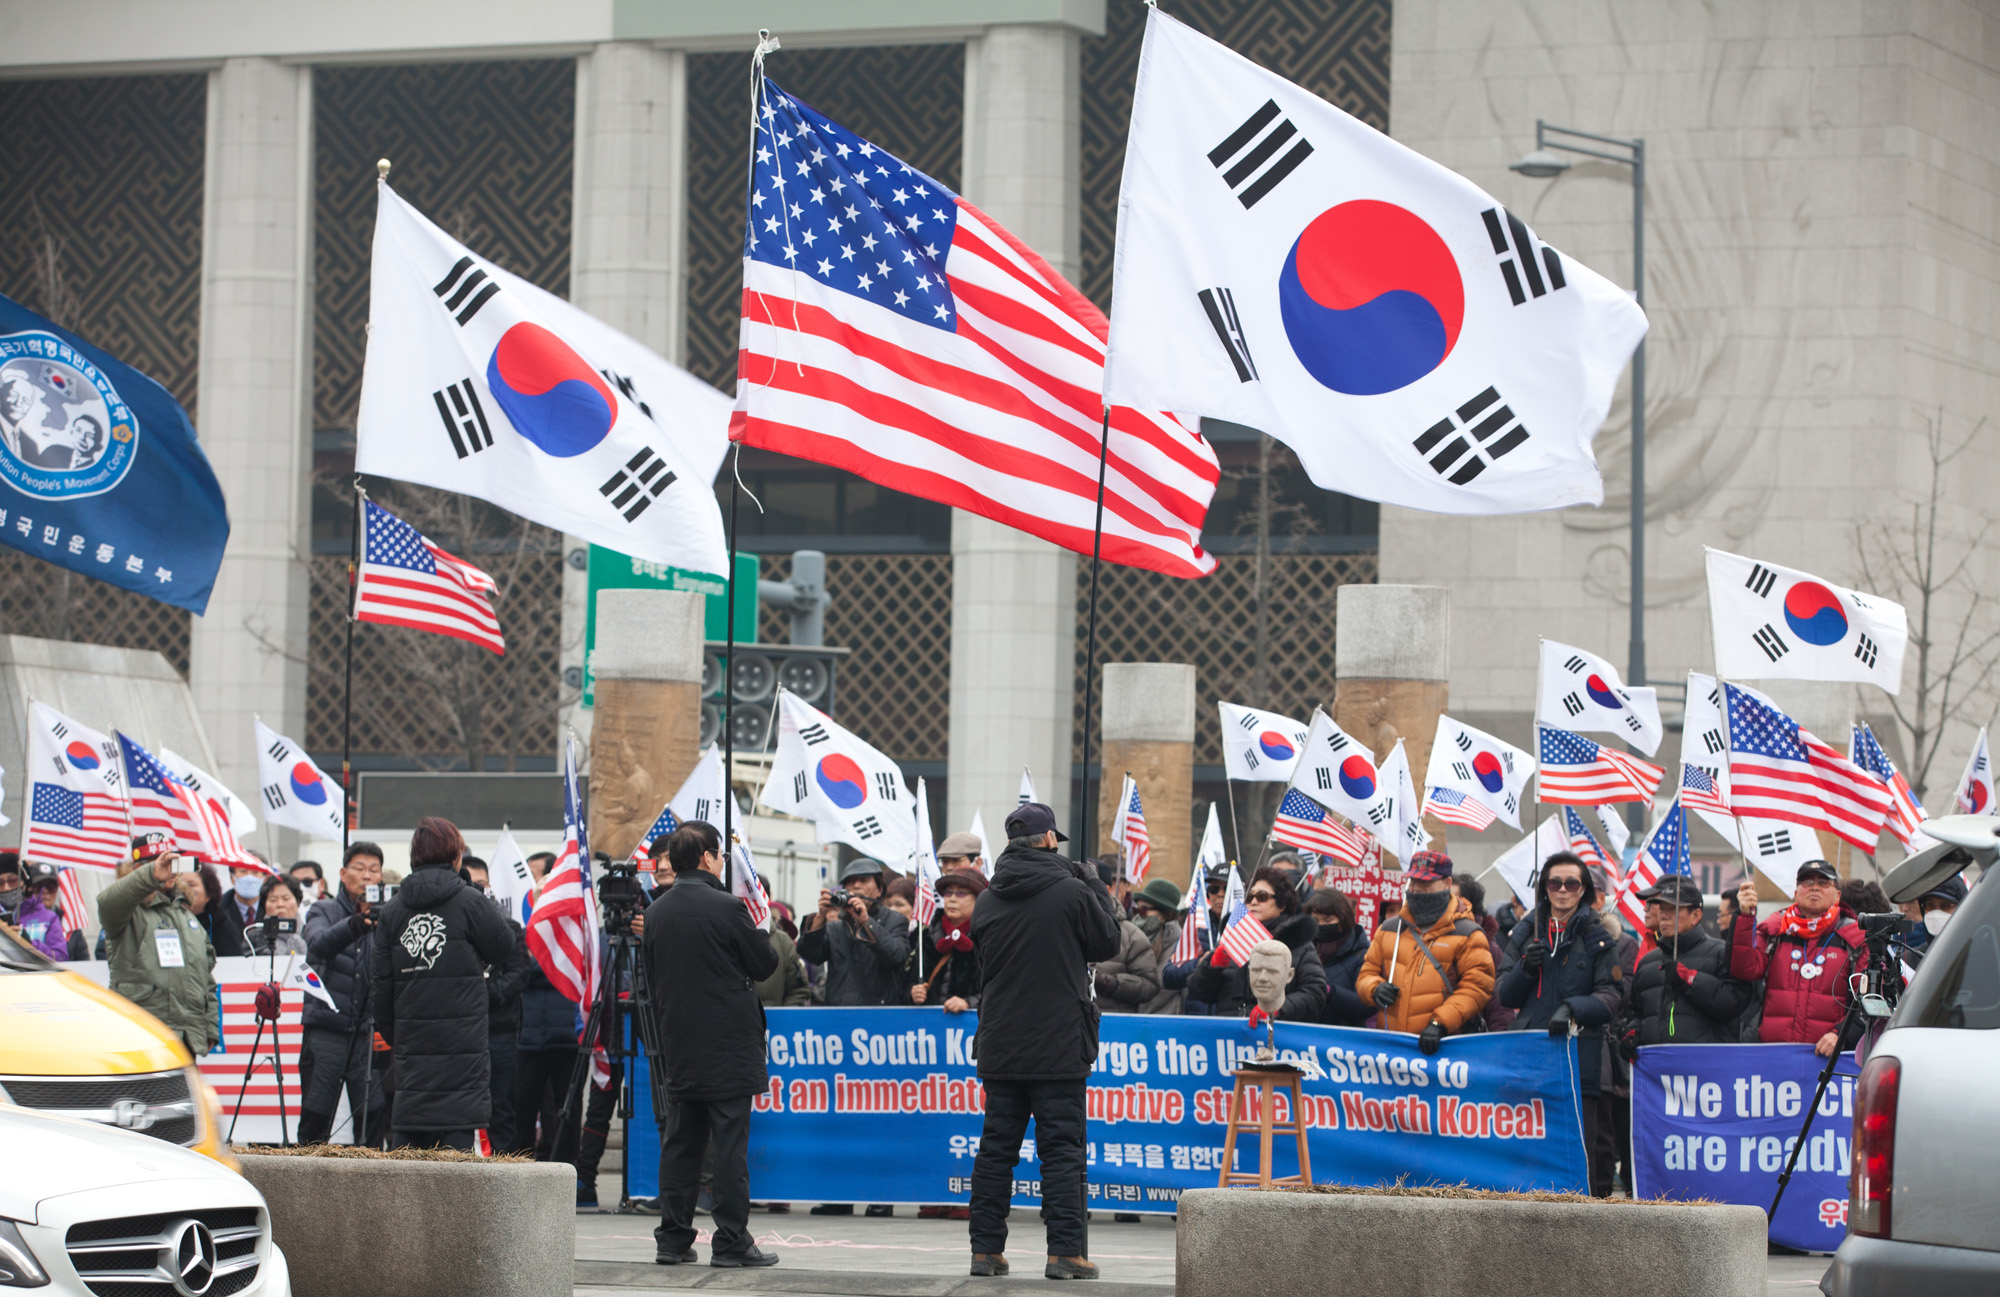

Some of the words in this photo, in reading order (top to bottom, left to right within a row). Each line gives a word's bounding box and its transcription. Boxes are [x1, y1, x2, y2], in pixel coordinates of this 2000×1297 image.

[0, 450, 19, 478] ution
[21, 472, 61, 491] People's
[64, 468, 111, 489] Movement
[106, 443, 126, 471] Corps
[765, 1028, 844, 1068] e,the
[851, 1028, 937, 1066] South
[946, 1028, 978, 1067] Ko
[1155, 1038, 1208, 1076] the
[1326, 1046, 1430, 1088] States
[1437, 1057, 1470, 1089] to
[789, 1078, 829, 1113] an
[1303, 1094, 1340, 1130] on
[1340, 1091, 1433, 1135] North
[1437, 1095, 1547, 1139] Korea!
[1660, 1075, 1722, 1118] We
[1733, 1075, 1801, 1118] the
[1816, 1076, 1858, 1117] ci
[1104, 1143, 1164, 1168] 북폭을
[1664, 1134, 1727, 1172] are
[1740, 1129, 1852, 1177] ready
[1819, 1198, 1849, 1228] 우
